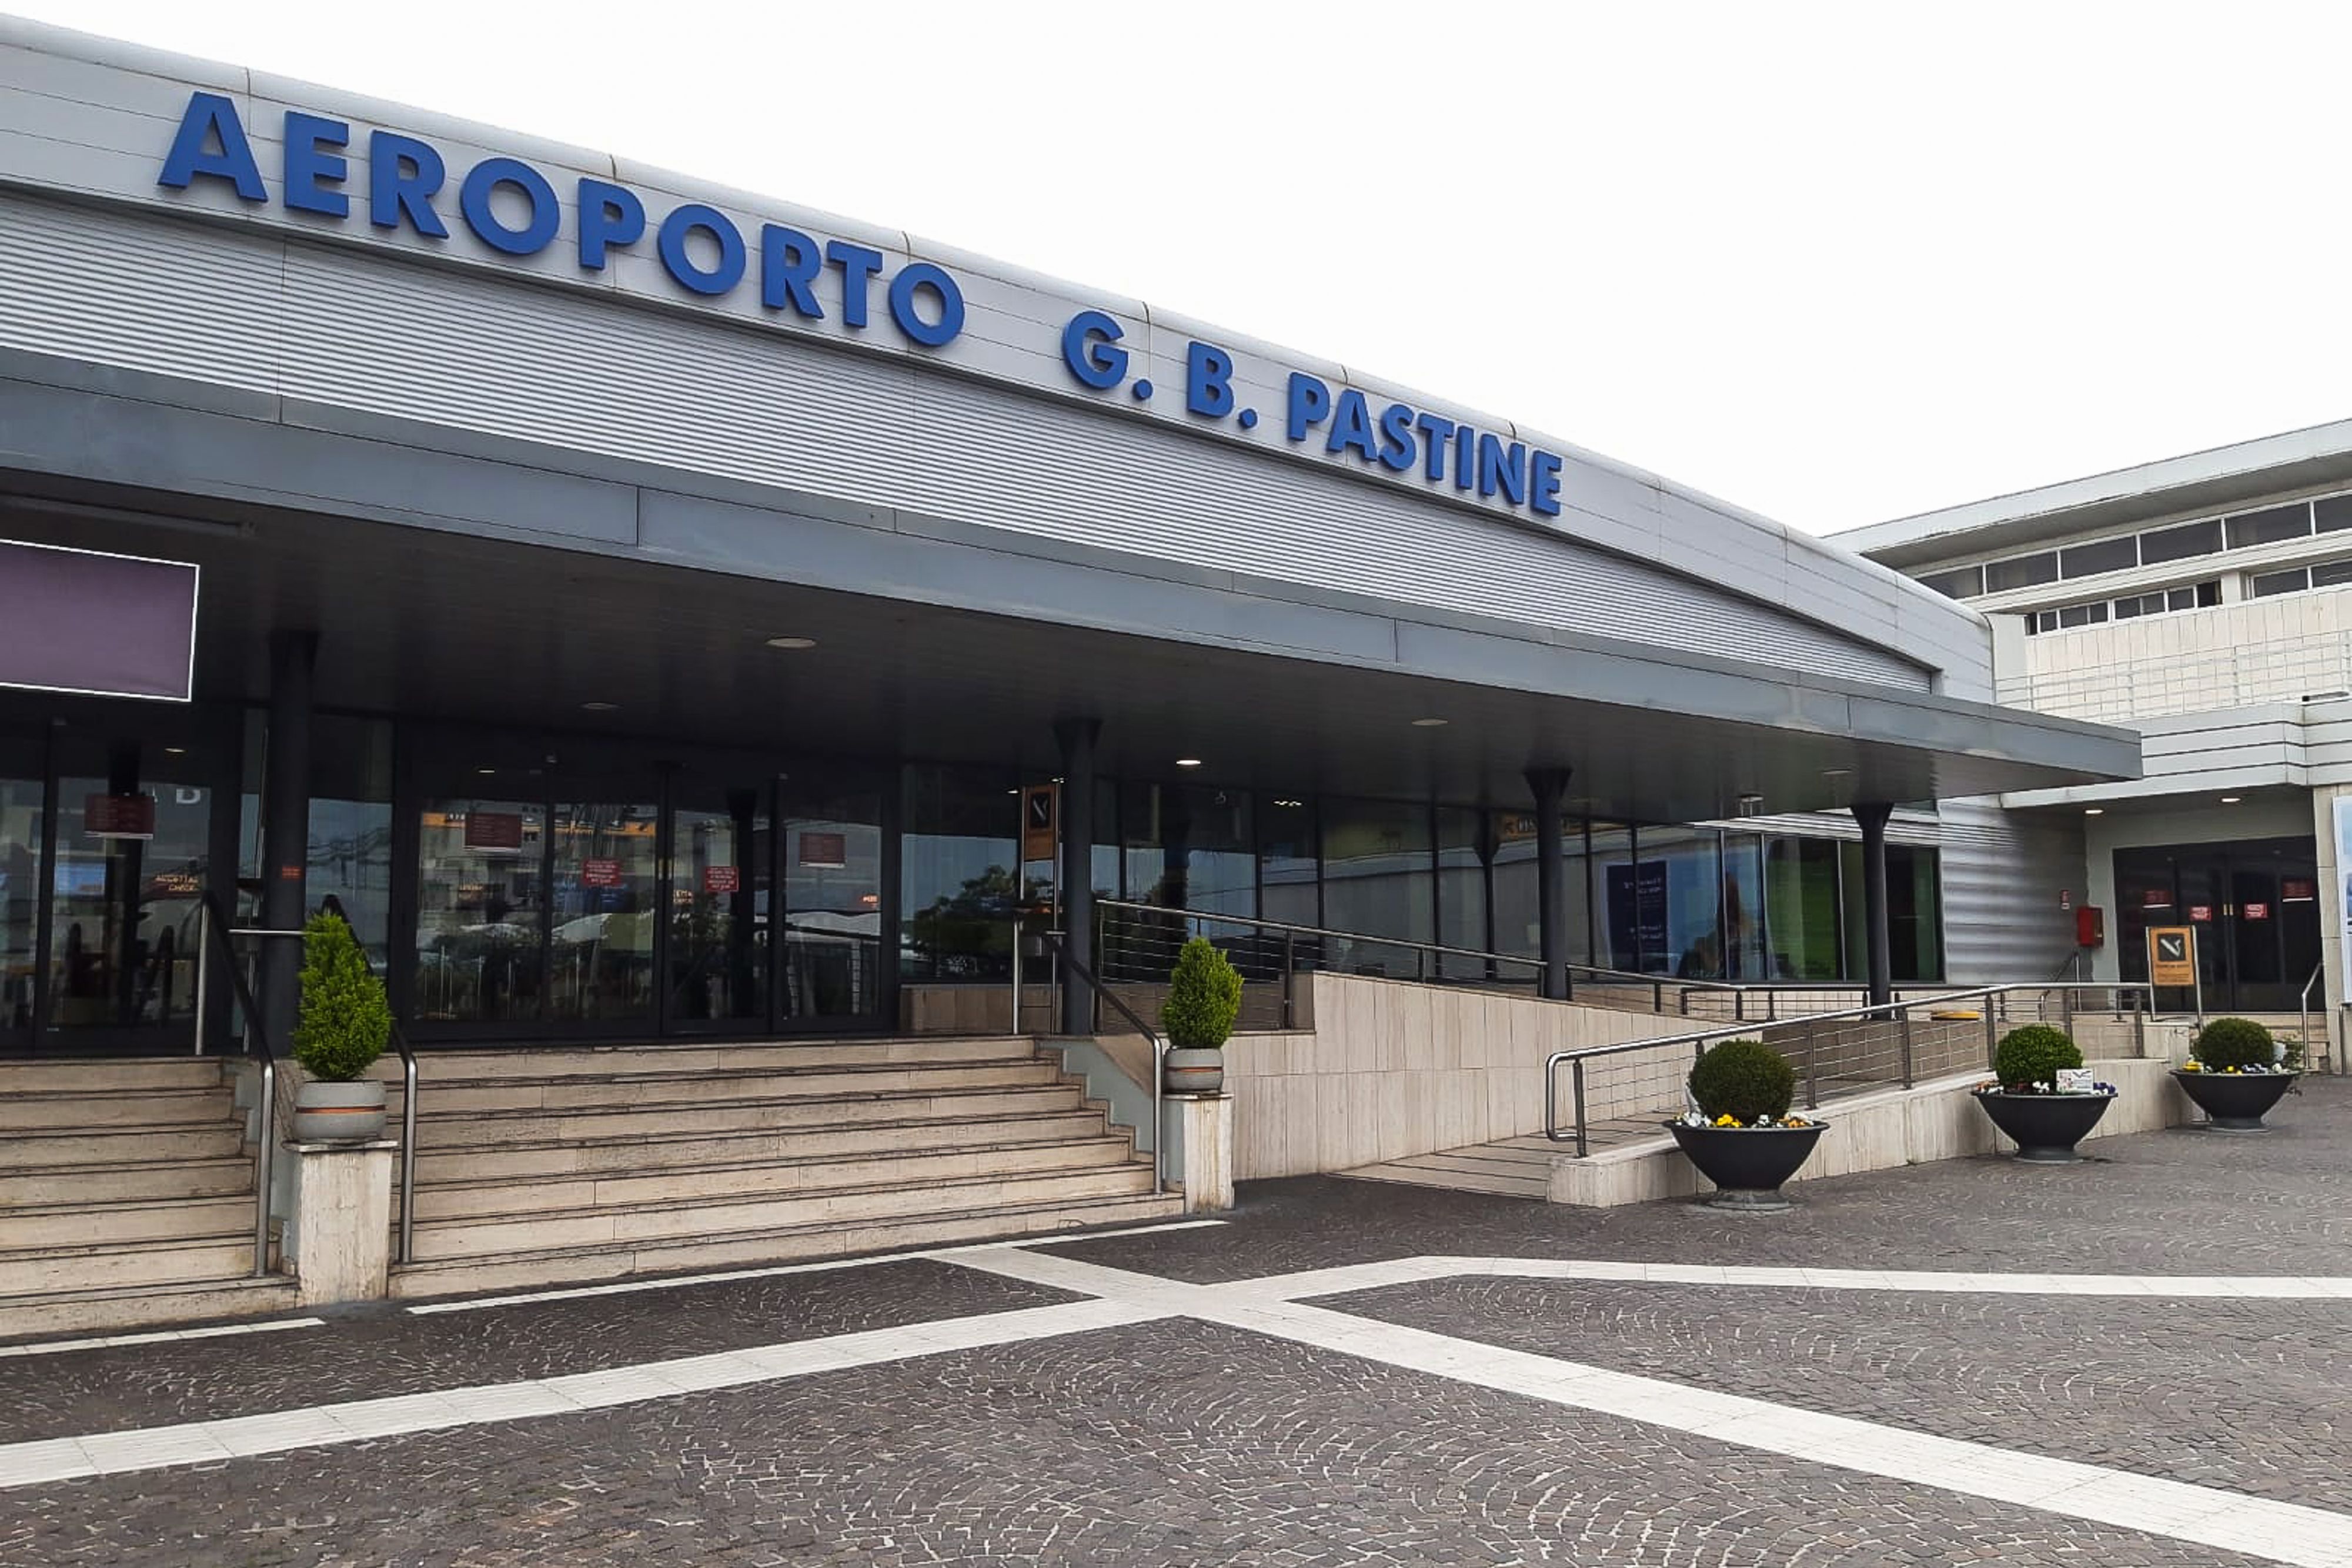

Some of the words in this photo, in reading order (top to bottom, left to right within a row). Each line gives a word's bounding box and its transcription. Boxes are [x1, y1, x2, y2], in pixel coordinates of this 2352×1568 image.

[158, 91, 965, 347] AEROPORTO
[1061, 310, 1152, 400] G.
[1187, 341, 1258, 429] B.
[1287, 372, 1562, 516] PASTINE
